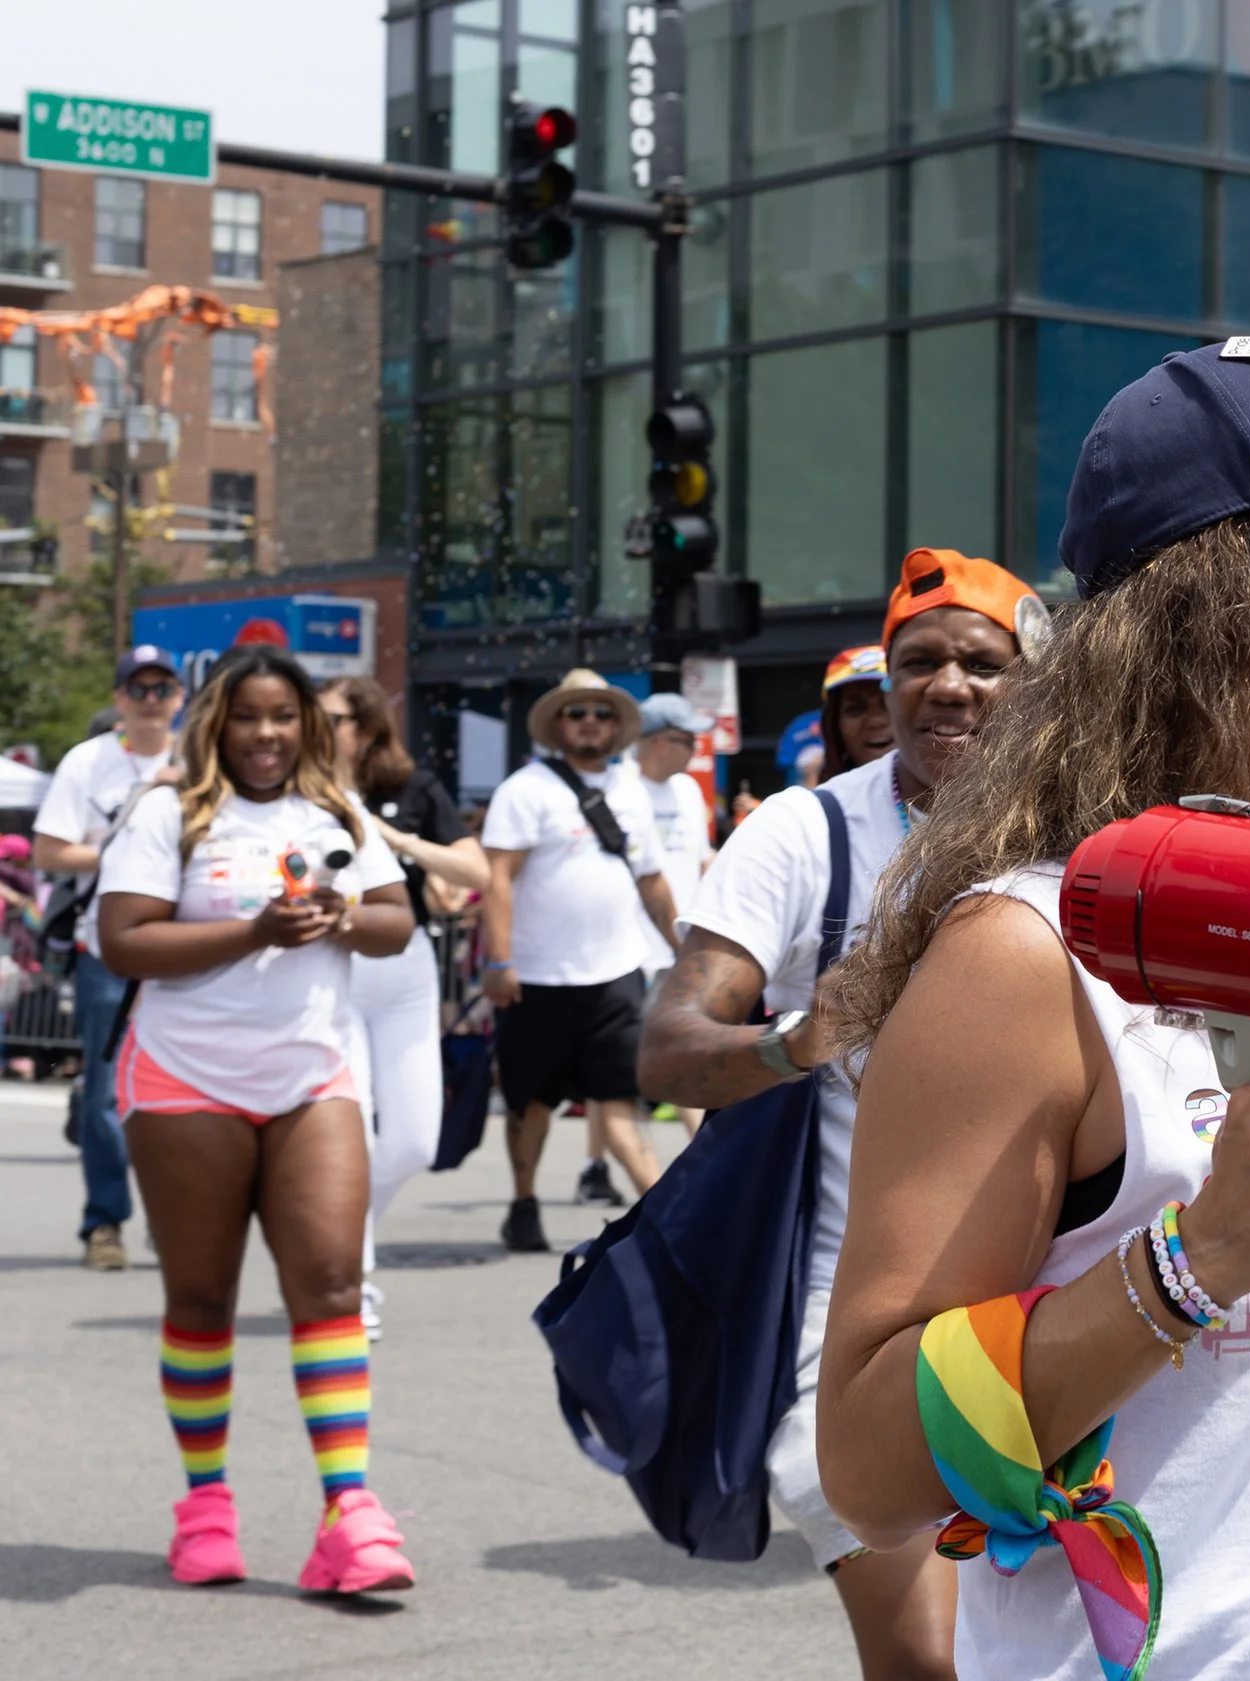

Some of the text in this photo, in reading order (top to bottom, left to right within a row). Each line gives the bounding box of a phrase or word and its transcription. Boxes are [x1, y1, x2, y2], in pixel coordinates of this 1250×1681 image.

[57, 98, 176, 142] ADDISON
[182, 119, 204, 141] ST
[627, 5, 657, 188] HA3601
